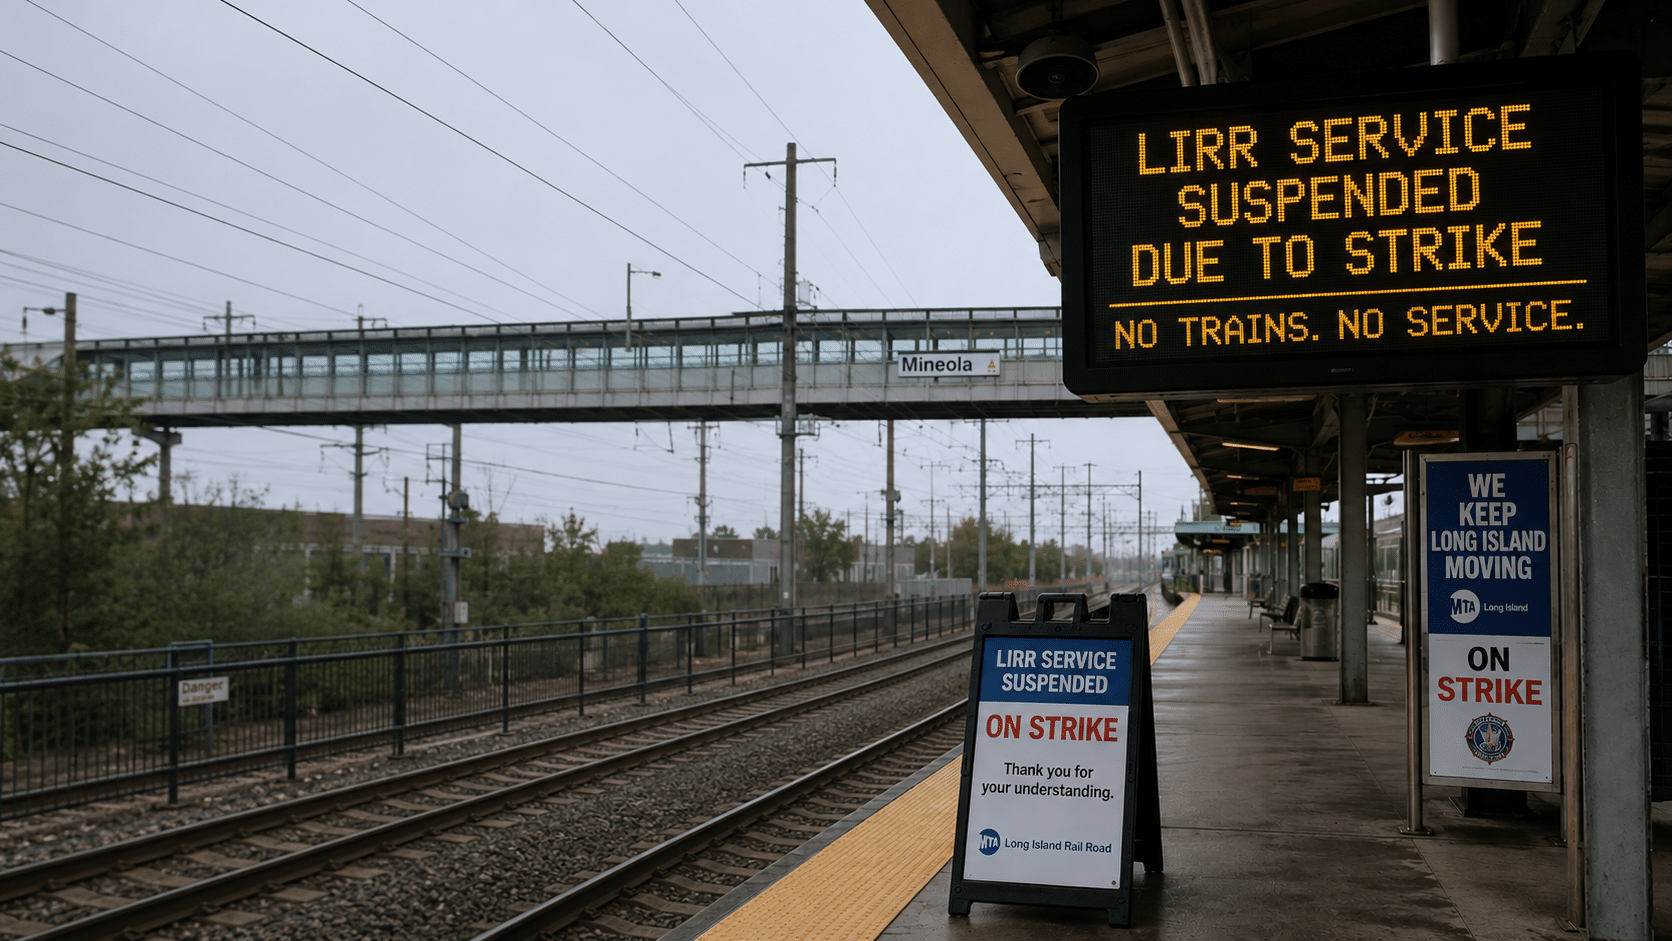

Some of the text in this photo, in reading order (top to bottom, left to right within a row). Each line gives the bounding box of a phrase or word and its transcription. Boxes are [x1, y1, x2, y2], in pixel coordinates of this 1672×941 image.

[1138, 103, 1532, 175] LIRR SERVICE
[1178, 166, 1480, 228] SUSPENDED
[1132, 220, 1543, 287] DUE TO STRIKE
[1114, 299, 1584, 350] NO TRAINS. NO SERVICE.
[902, 356, 972, 372] Mineola
[1468, 473, 1506, 498] WE
[1459, 502, 1517, 526] KEEP
[1431, 530, 1546, 552] LONG ISLAND
[1445, 555, 1532, 580] MOVING
[1450, 598, 1528, 615] MTA Long Island
[996, 649, 1116, 670] LIRR SERVICE
[1468, 646, 1510, 671] ON
[182, 681, 224, 694] Danger
[1002, 673, 1108, 694] SUSPENDED
[1438, 676, 1542, 705] STRIKE
[986, 714, 1118, 742] ON STRIKE
[1004, 762, 1094, 780] Thank you for
[981, 782, 1114, 801] your understanding.
[978, 834, 1112, 853] MTA Long Island Rail Road
